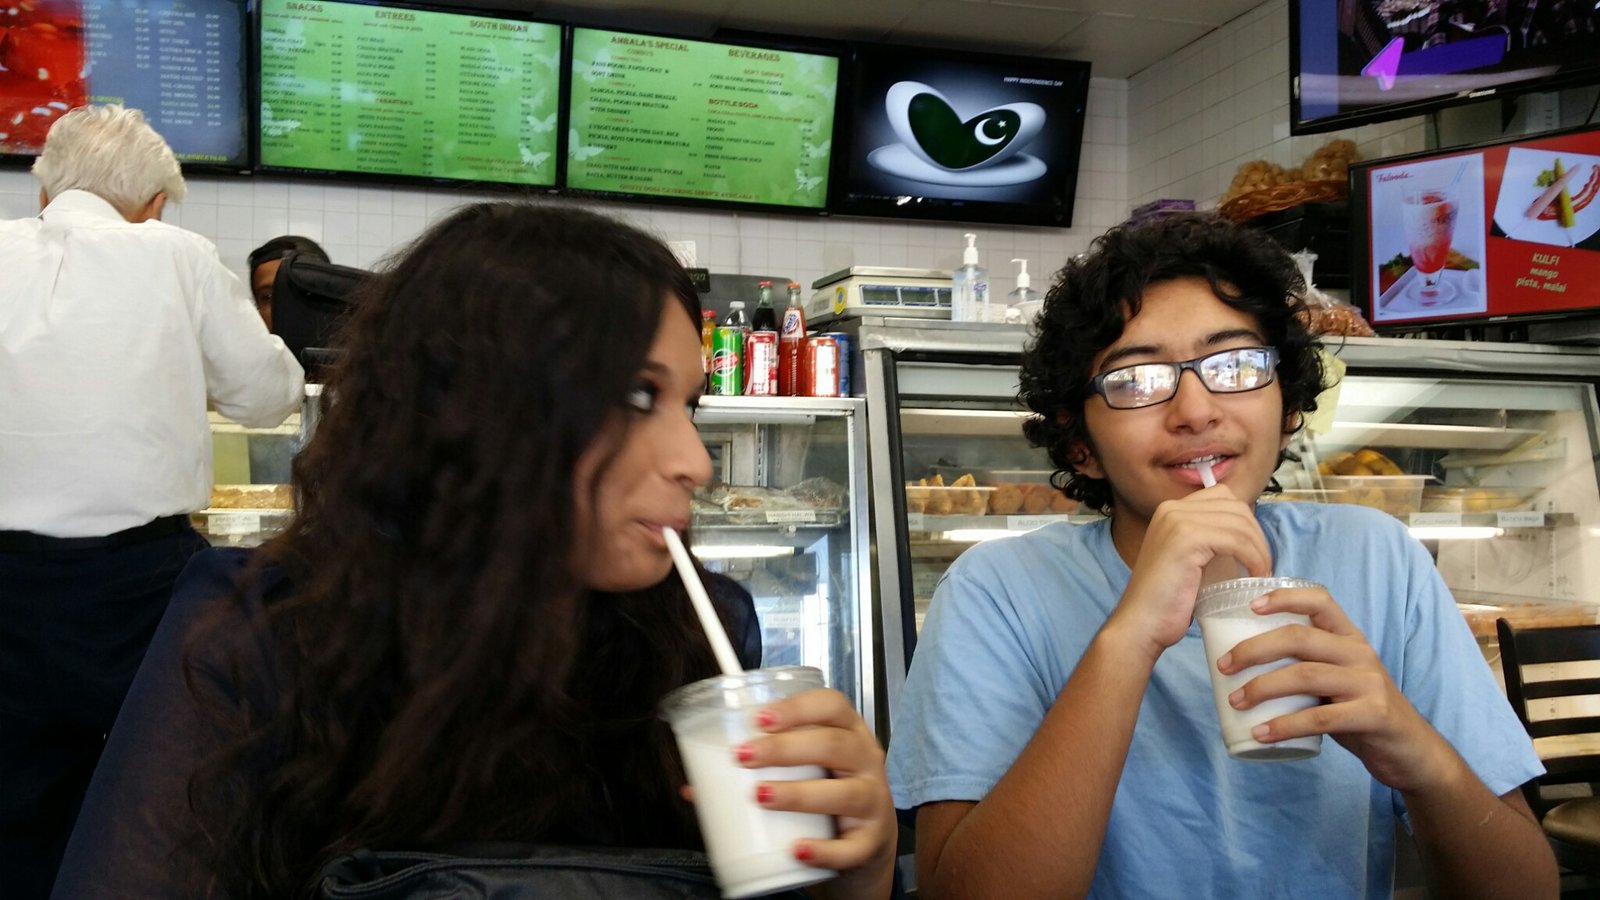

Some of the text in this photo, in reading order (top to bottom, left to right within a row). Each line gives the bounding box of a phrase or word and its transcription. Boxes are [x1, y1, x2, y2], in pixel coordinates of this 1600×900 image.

[287, 2, 322, 12] SNACKS
[375, 10, 416, 22] ENTREES
[470, 20, 528, 33] SOUTH INDIAN
[611, 36, 688, 52] AMBALA'S SPECIAL
[728, 49, 780, 61] BEVERAGES
[1532, 253, 1560, 266] KULFI
[1530, 267, 1559, 279] mango
[1543, 281, 1567, 293] malai
